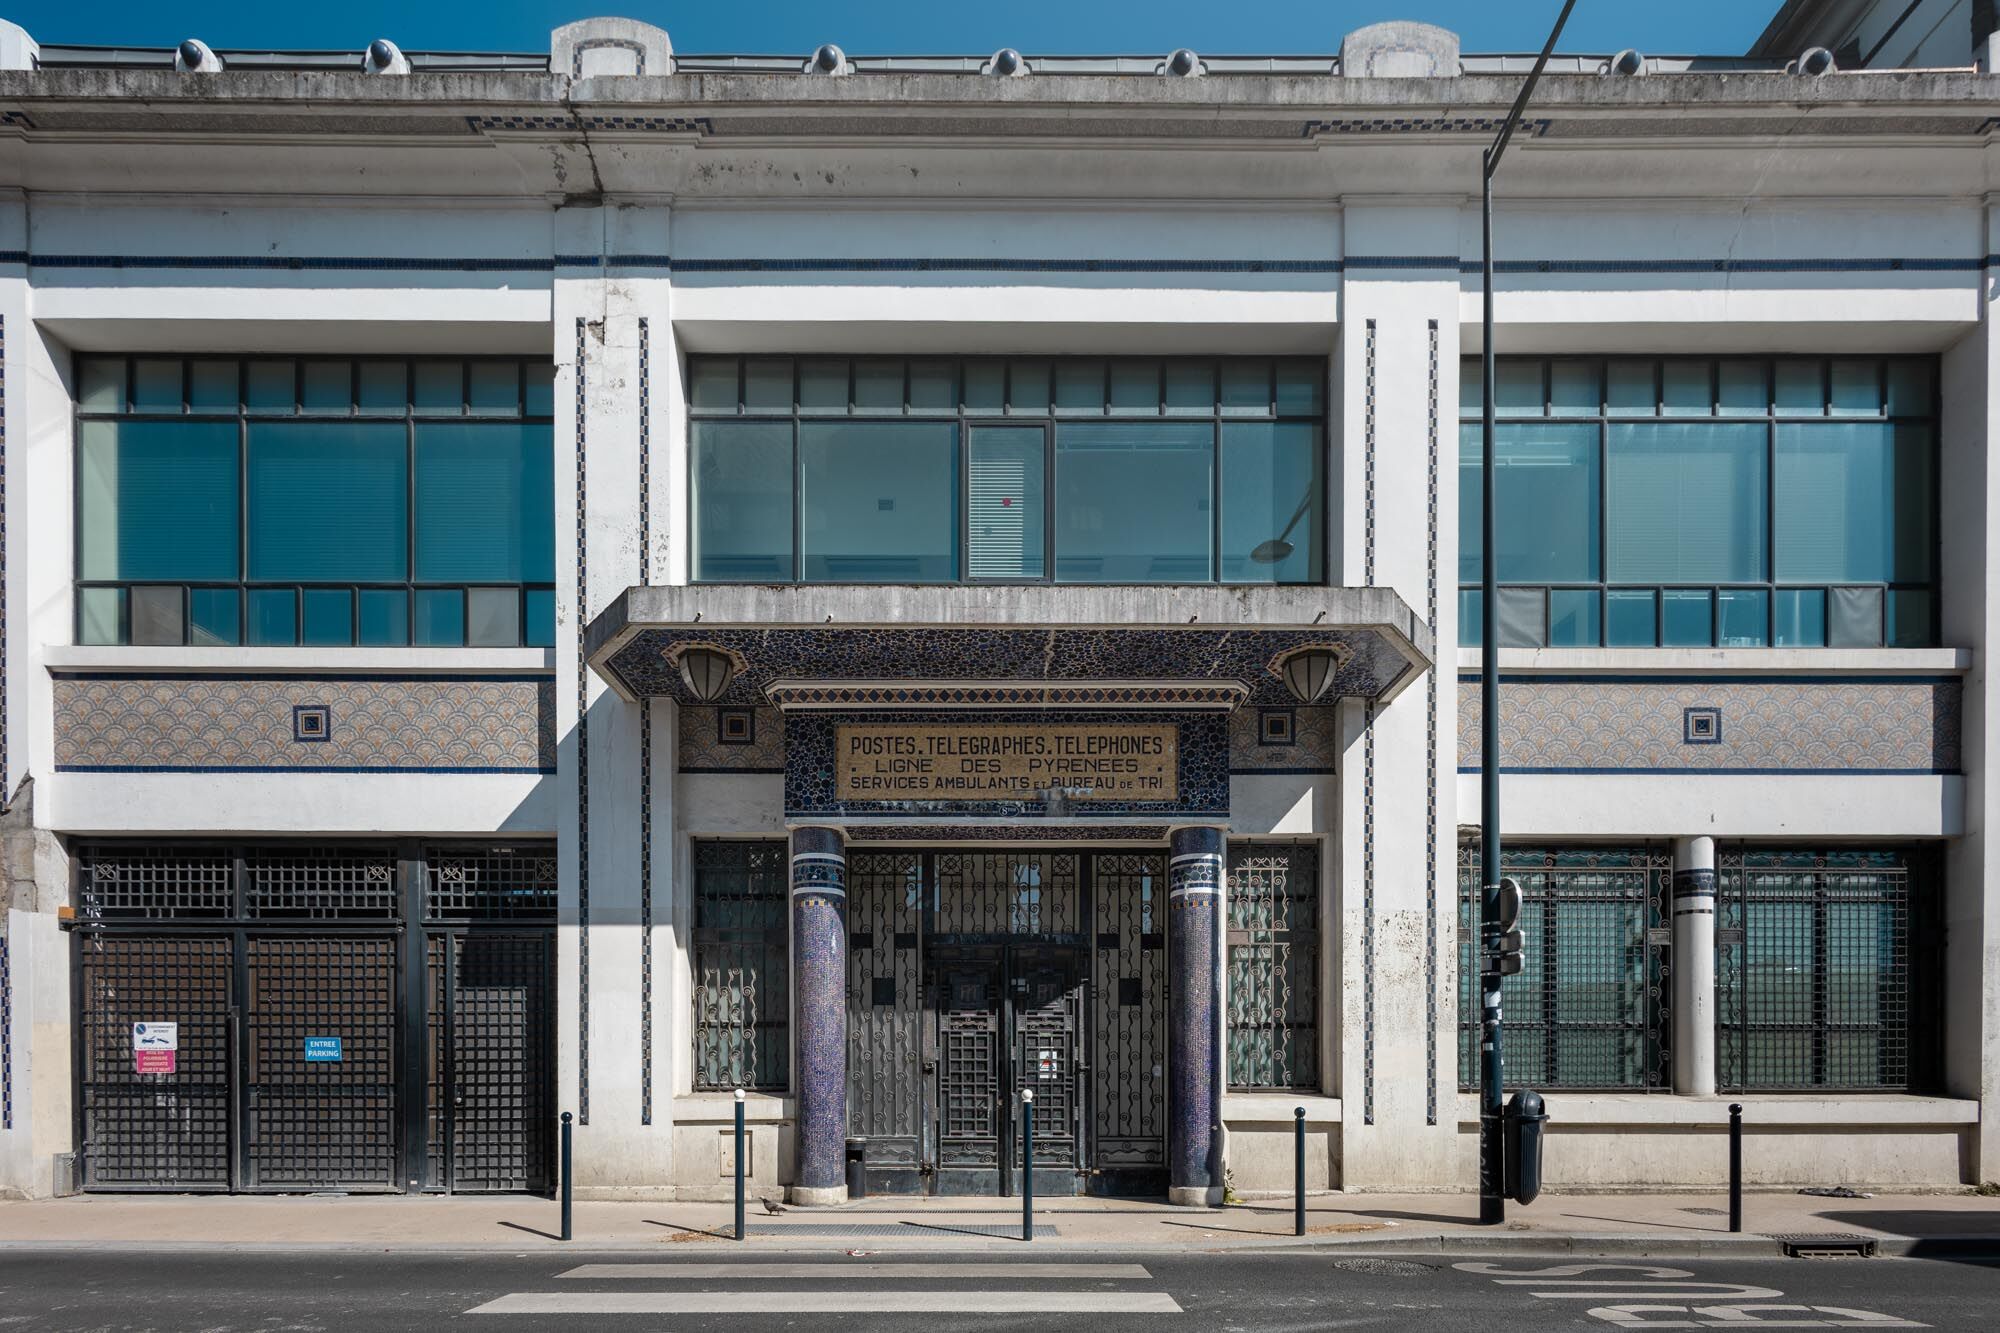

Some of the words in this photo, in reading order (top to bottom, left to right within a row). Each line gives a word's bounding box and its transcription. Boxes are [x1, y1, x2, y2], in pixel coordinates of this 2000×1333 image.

[1055, 736, 1163, 755] TELEPHONES
[875, 758, 933, 773] LIGNE
[961, 758, 1001, 773] DES
[1029, 758, 1138, 773] PYRENEES
[851, 776, 929, 789] SERVICES
[935, 776, 1030, 789] AMBULANTS
[1034, 781, 1046, 790] ET
[1051, 776, 1115, 790] BUREAU
[1120, 781, 1133, 789] DE
[1139, 776, 1163, 789] TRI
